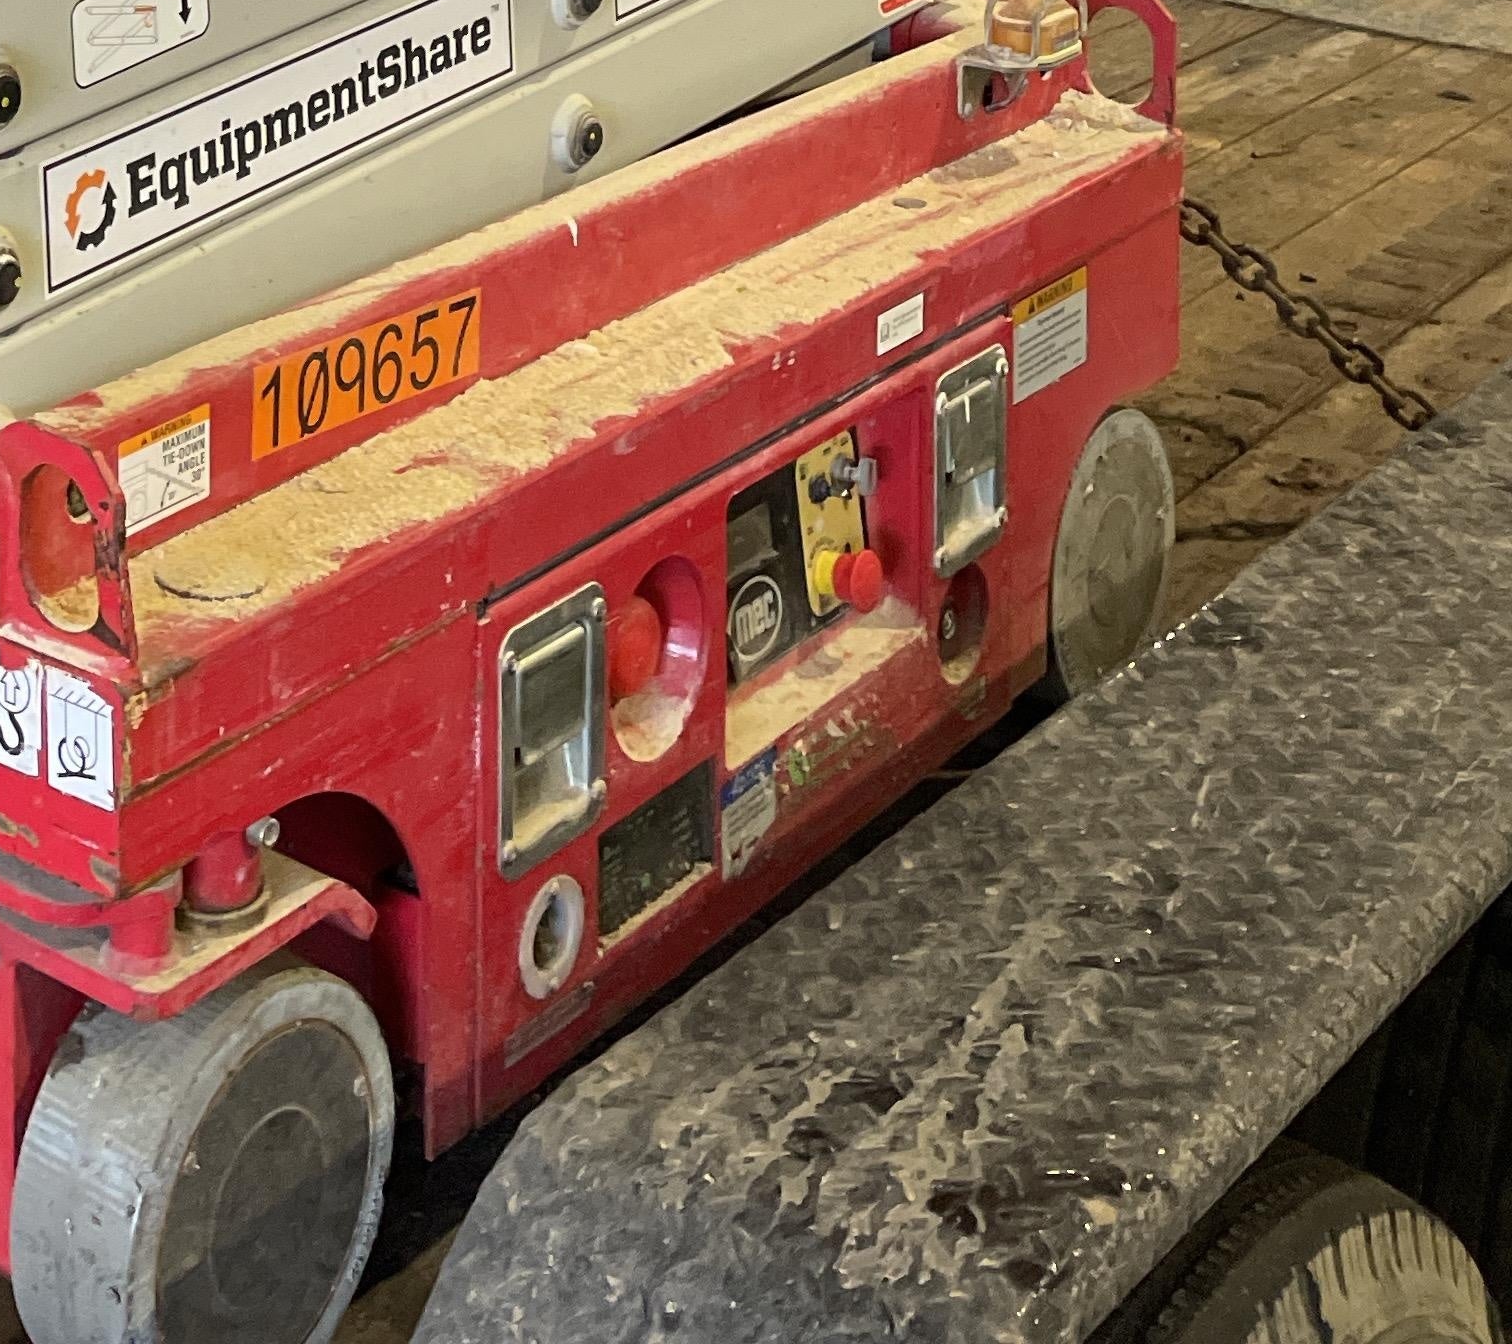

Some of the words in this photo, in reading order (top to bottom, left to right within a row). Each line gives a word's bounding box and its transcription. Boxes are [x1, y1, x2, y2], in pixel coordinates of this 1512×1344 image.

[260, 296, 478, 447] 109657
[161, 422, 206, 454] MAXIMUM
[162, 437, 206, 467] TIE-DOWN
[176, 451, 206, 476] ANGLE
